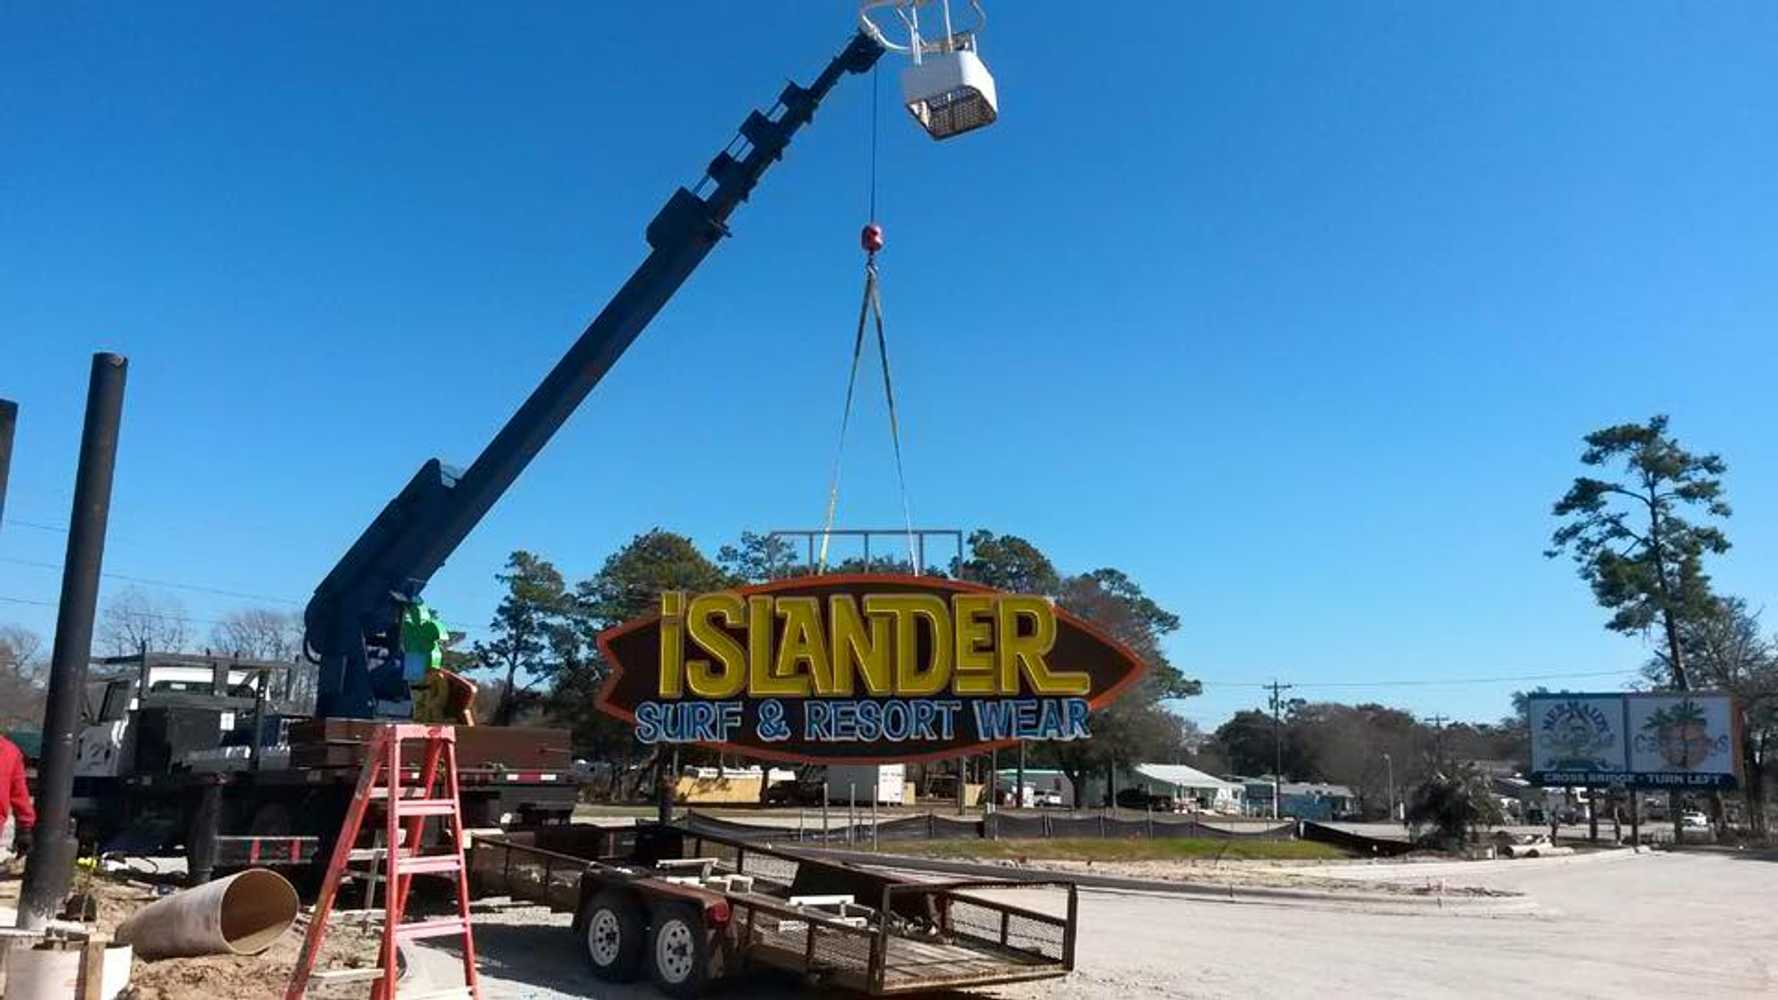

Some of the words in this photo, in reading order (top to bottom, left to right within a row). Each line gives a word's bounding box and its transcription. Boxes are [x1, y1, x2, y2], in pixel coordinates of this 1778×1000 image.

[635, 700, 743, 744] SURF
[757, 700, 791, 742] &
[804, 700, 961, 743] RESORT
[973, 699, 1092, 743] WEAR
[1646, 774, 1684, 785] TURN
